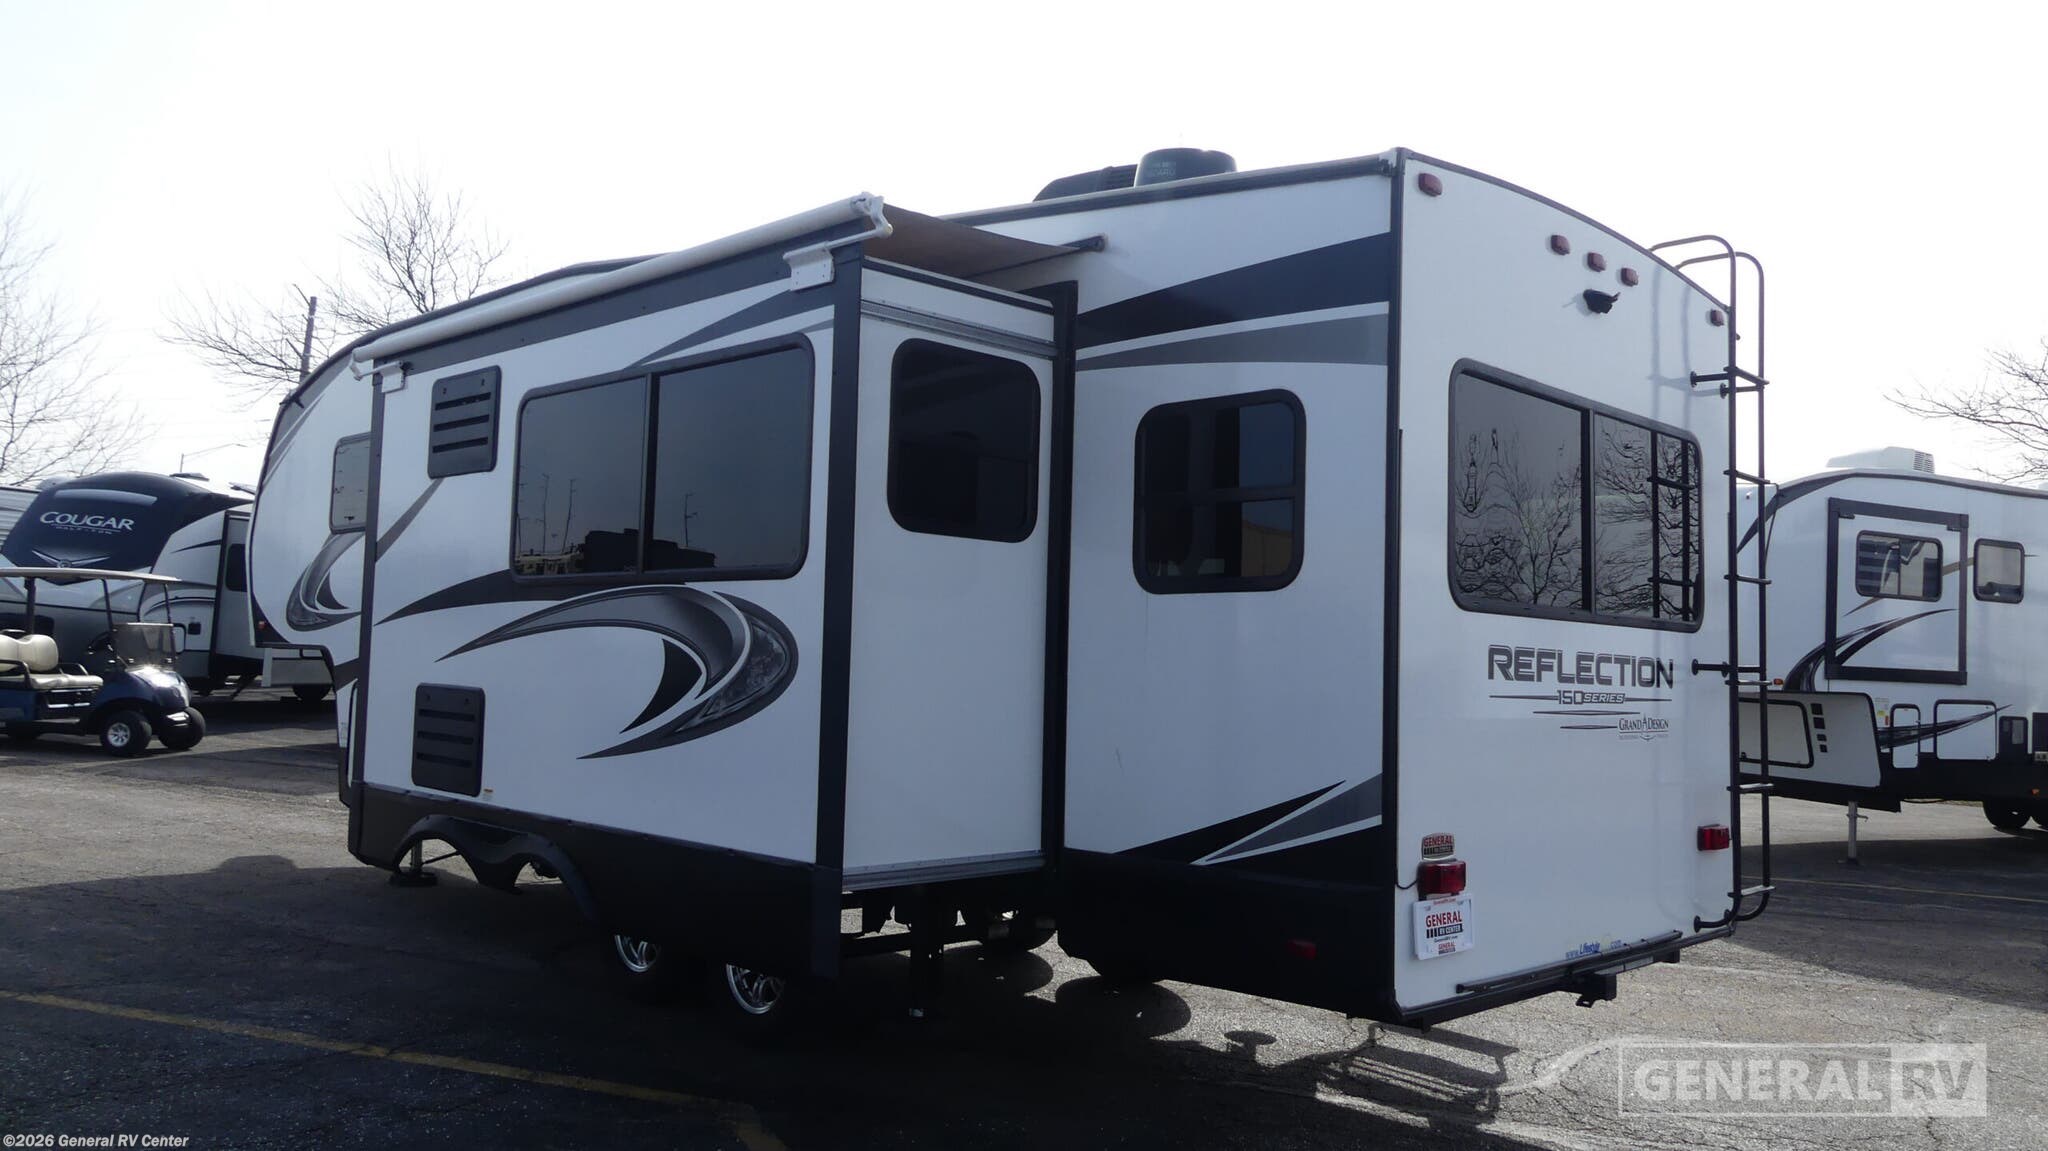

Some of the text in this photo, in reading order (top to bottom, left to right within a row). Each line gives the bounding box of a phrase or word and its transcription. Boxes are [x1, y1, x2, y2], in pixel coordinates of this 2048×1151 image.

[40, 511, 135, 531] COUGAR
[1488, 644, 1674, 689] REFLECTION
[1584, 693, 1625, 704] SERIES
[1425, 911, 1463, 928] GENERAL
